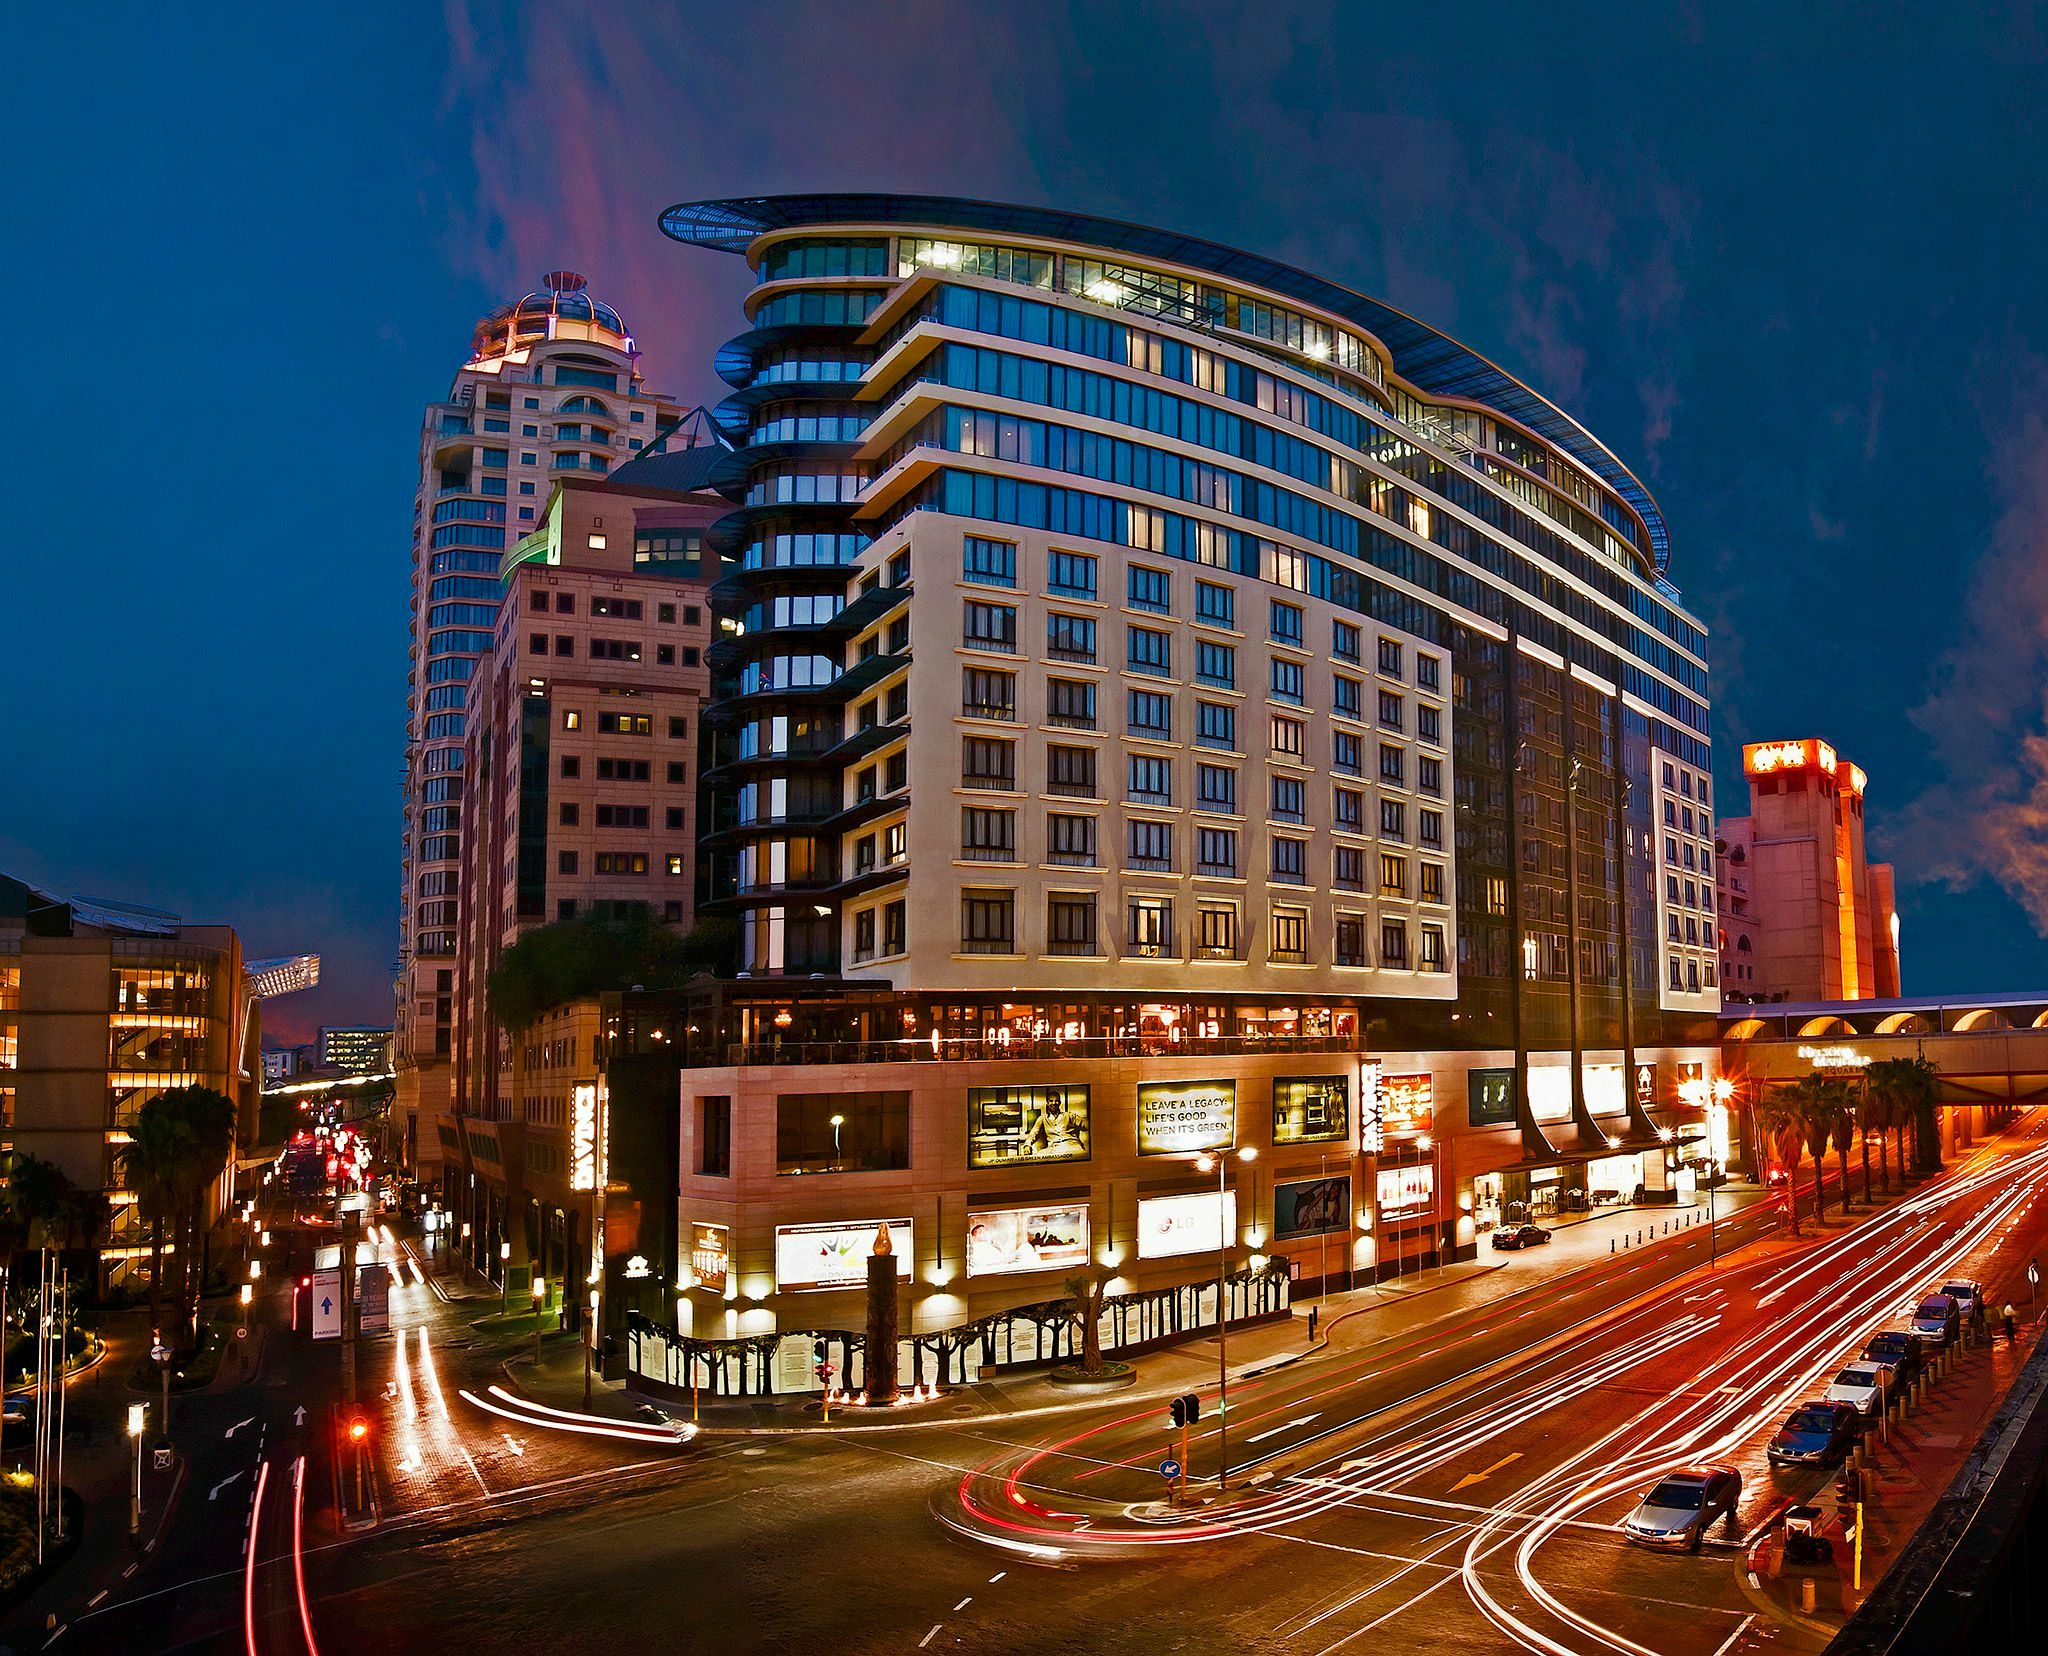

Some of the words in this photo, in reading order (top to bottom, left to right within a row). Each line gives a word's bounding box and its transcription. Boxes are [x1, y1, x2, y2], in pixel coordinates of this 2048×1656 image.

[1146, 1101, 1177, 1110] LEAVE
[1179, 1101, 1187, 1109] A
[1189, 1098, 1227, 1108] LEGACY:
[1146, 1113, 1175, 1123] LIFE'S
[1178, 1112, 1207, 1121] GOOD
[1146, 1126, 1175, 1136] WHEN
[1178, 1125, 1195, 1133] IT'S
[1197, 1122, 1229, 1132] GREEN.
[1177, 1216, 1194, 1229] LG
